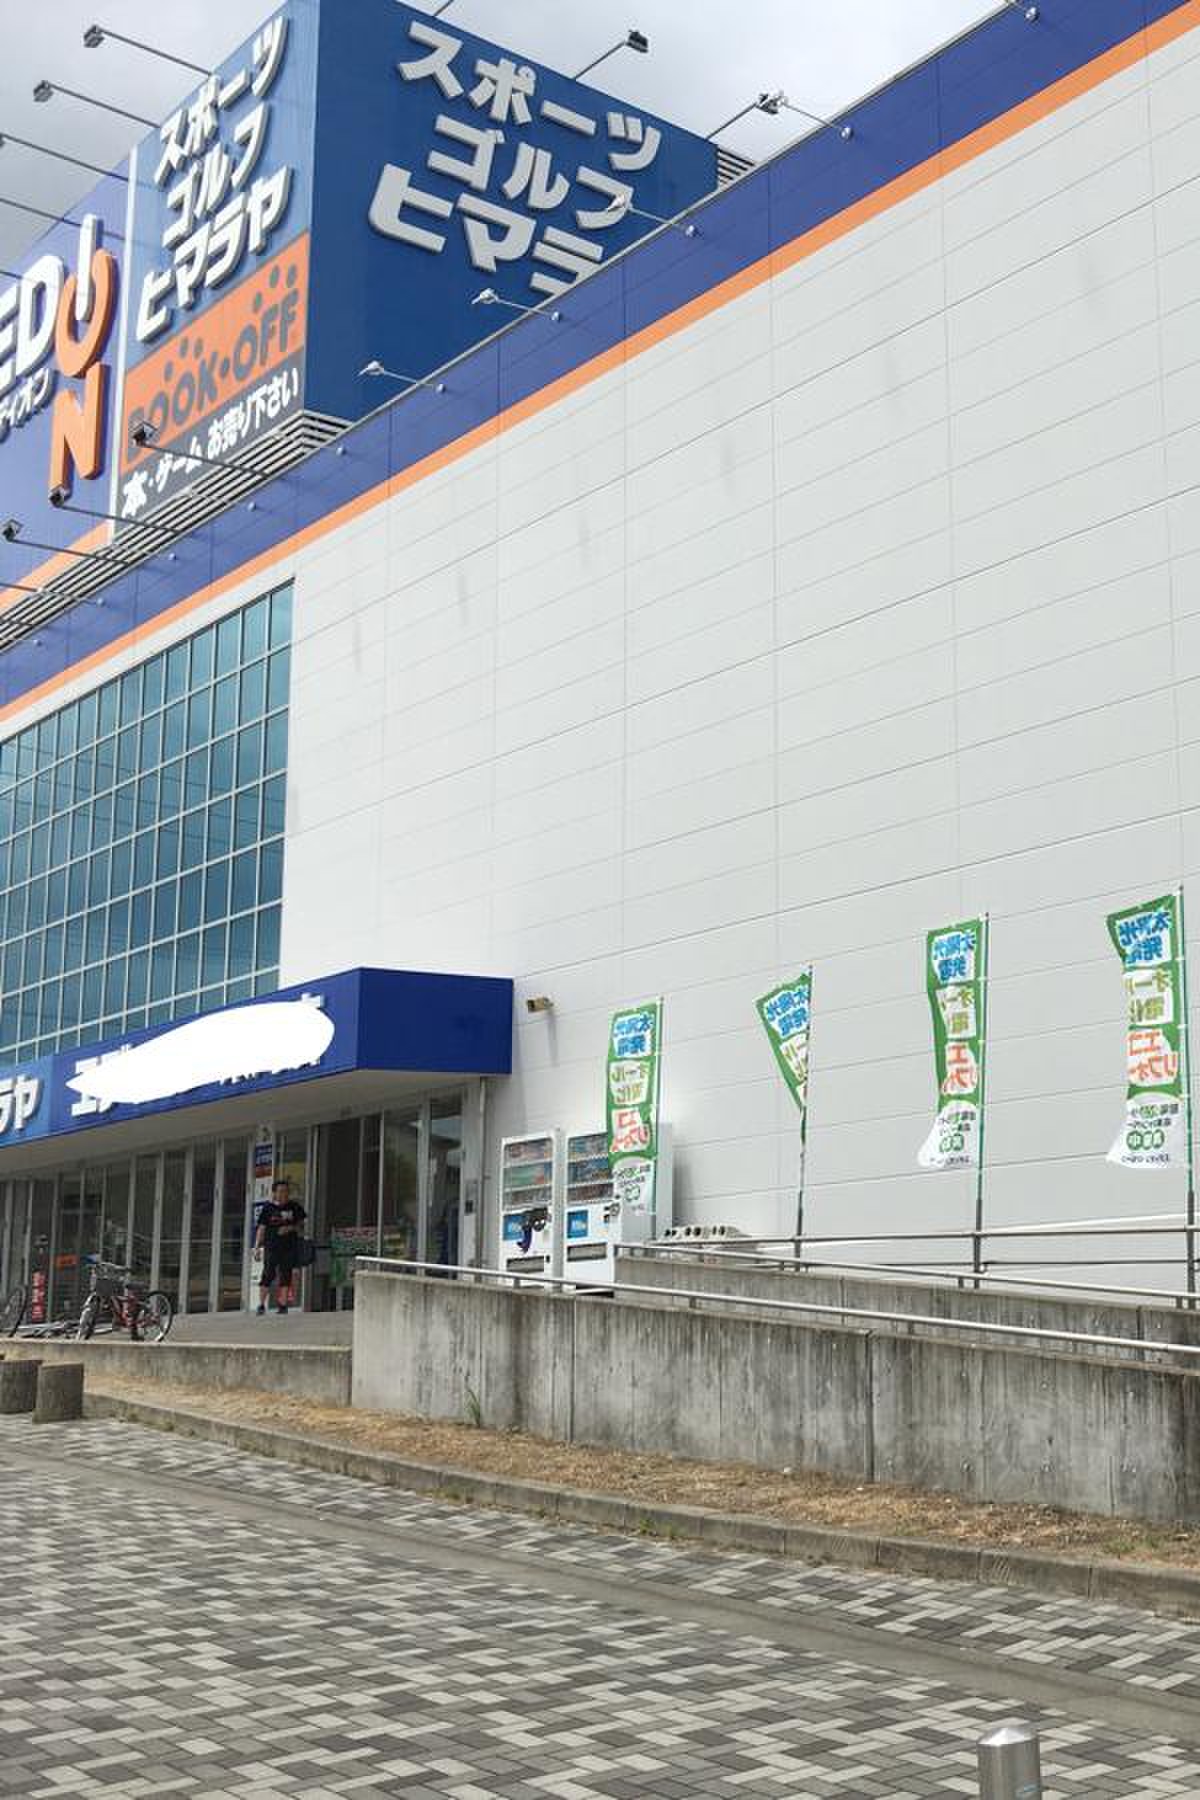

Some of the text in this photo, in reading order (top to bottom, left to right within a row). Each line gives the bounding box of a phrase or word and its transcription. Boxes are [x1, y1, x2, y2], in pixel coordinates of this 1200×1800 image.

[154, 15, 289, 186] スポーツ
[397, 20, 662, 172] スポーツ
[161, 101, 270, 249] ゴルフ
[427, 113, 635, 230] ゴルフ
[136, 165, 291, 343] ヒマラヤ
[207, 367, 300, 460] お売り下さい
